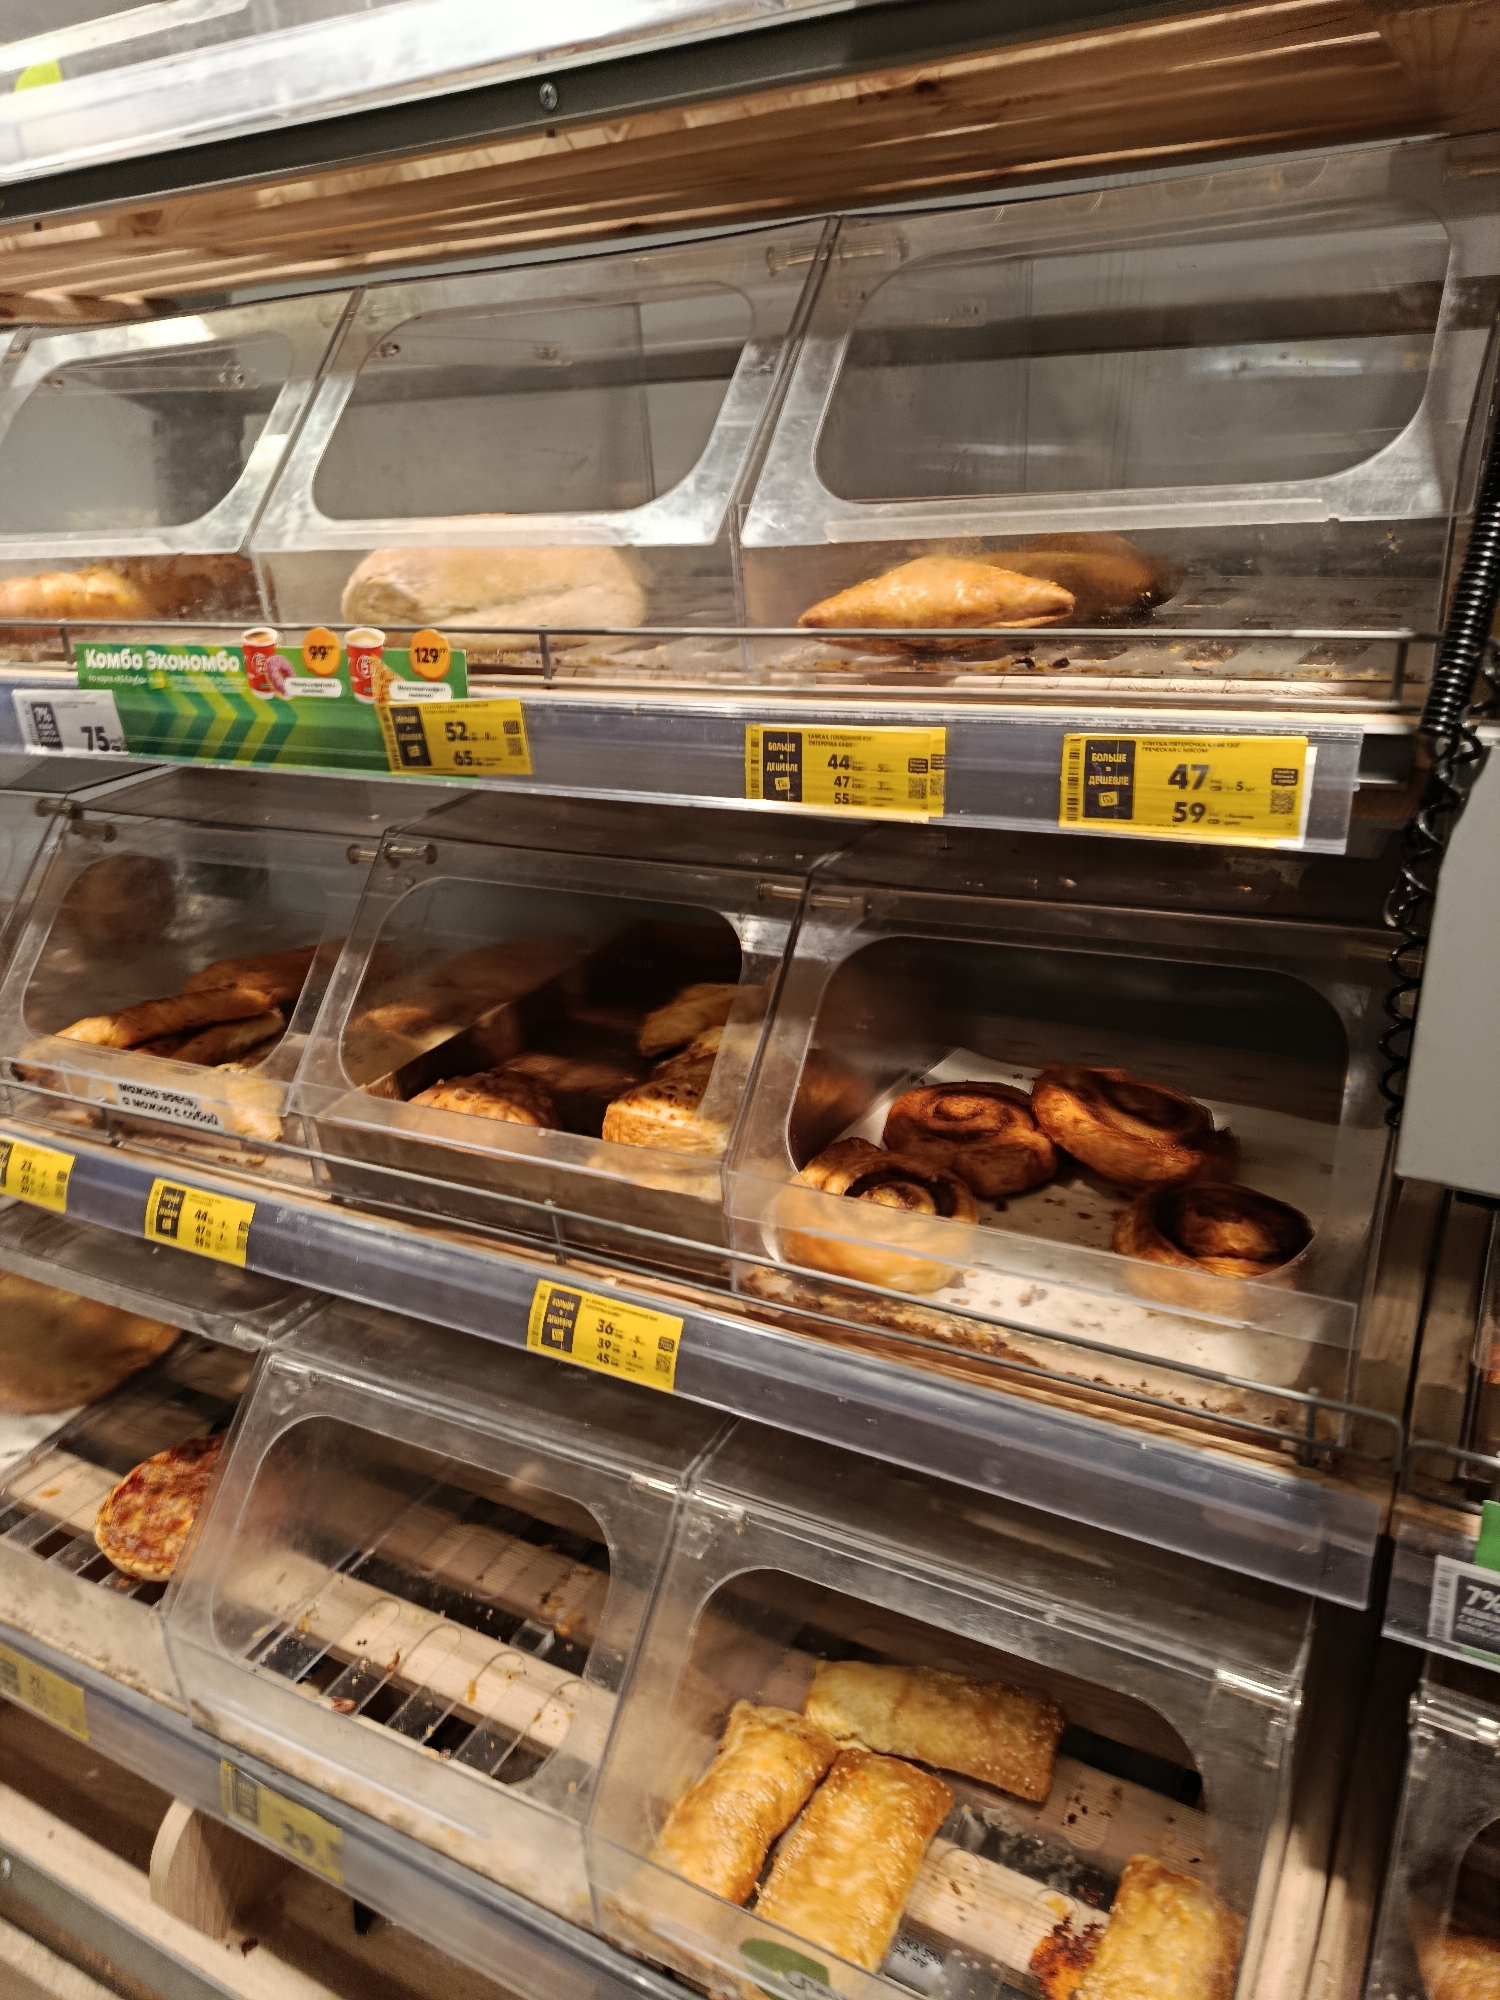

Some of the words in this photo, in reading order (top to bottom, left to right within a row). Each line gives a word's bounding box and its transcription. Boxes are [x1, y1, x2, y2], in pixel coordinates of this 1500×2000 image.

[85, 648, 143, 670] Комбо
[145, 649, 240, 673] Экономбо
[414, 647, 439, 663] 129
[81, 726, 110, 752] 75
[444, 721, 468, 742] 52
[768, 742, 796, 752] БОЛЬШЕ
[453, 750, 473, 766] 65
[827, 754, 850, 770] 44
[1091, 752, 1127, 763] БОЛЬШЕ
[834, 775, 850, 788] 47
[1088, 775, 1129, 786] ДЕШЕВЛЕ
[1168, 764, 1209, 790] 47
[1235, 781, 1243, 791] 5
[834, 792, 850, 805] 55
[1172, 801, 1206, 823] 59
[596, 1318, 614, 1335] 36
[597, 1337, 612, 1350] 39
[596, 1352, 610, 1365] 45
